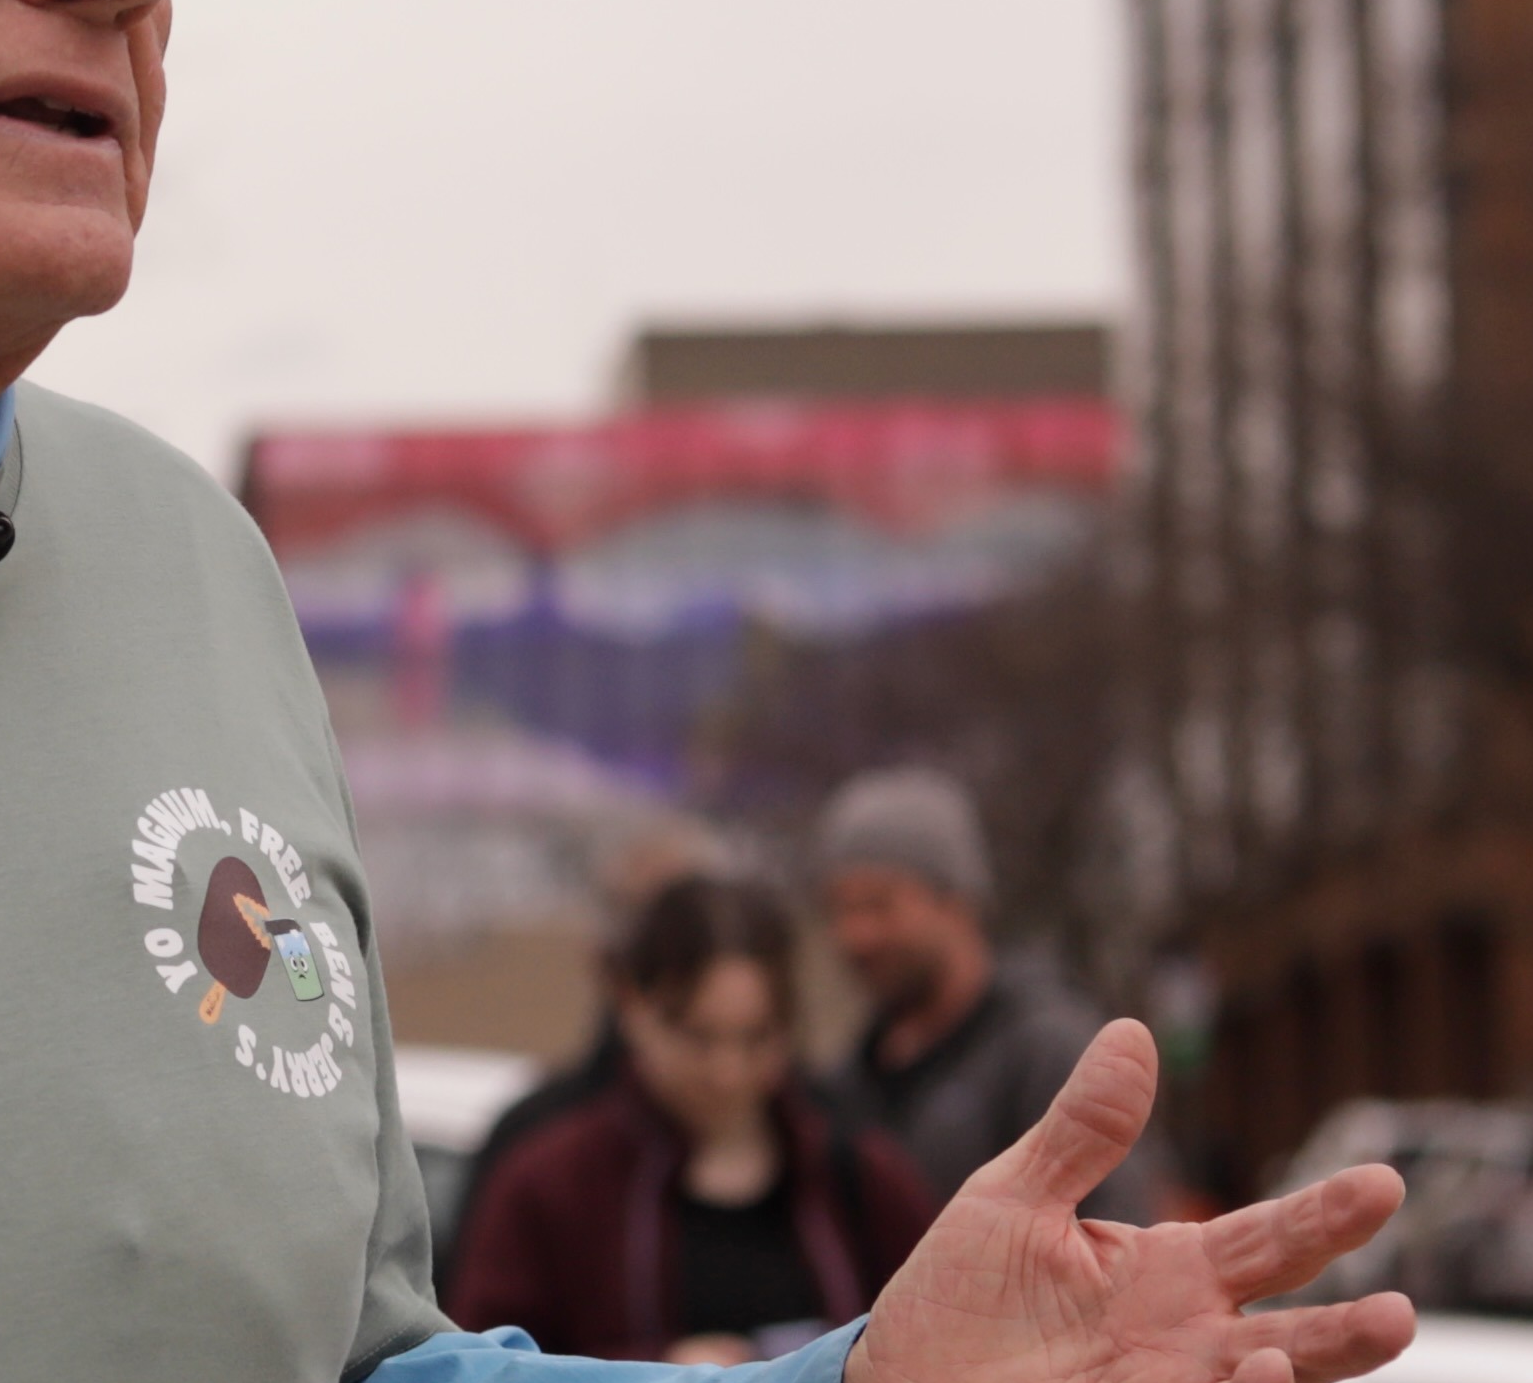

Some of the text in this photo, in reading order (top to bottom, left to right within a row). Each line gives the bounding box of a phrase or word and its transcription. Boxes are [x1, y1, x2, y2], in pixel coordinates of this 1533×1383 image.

[131, 788, 232, 910] MAGNUM,
[238, 807, 311, 908] FREE
[144, 928, 198, 994] YO
[309, 921, 357, 1010] BEN
[235, 1024, 342, 1098] JERRY'S
